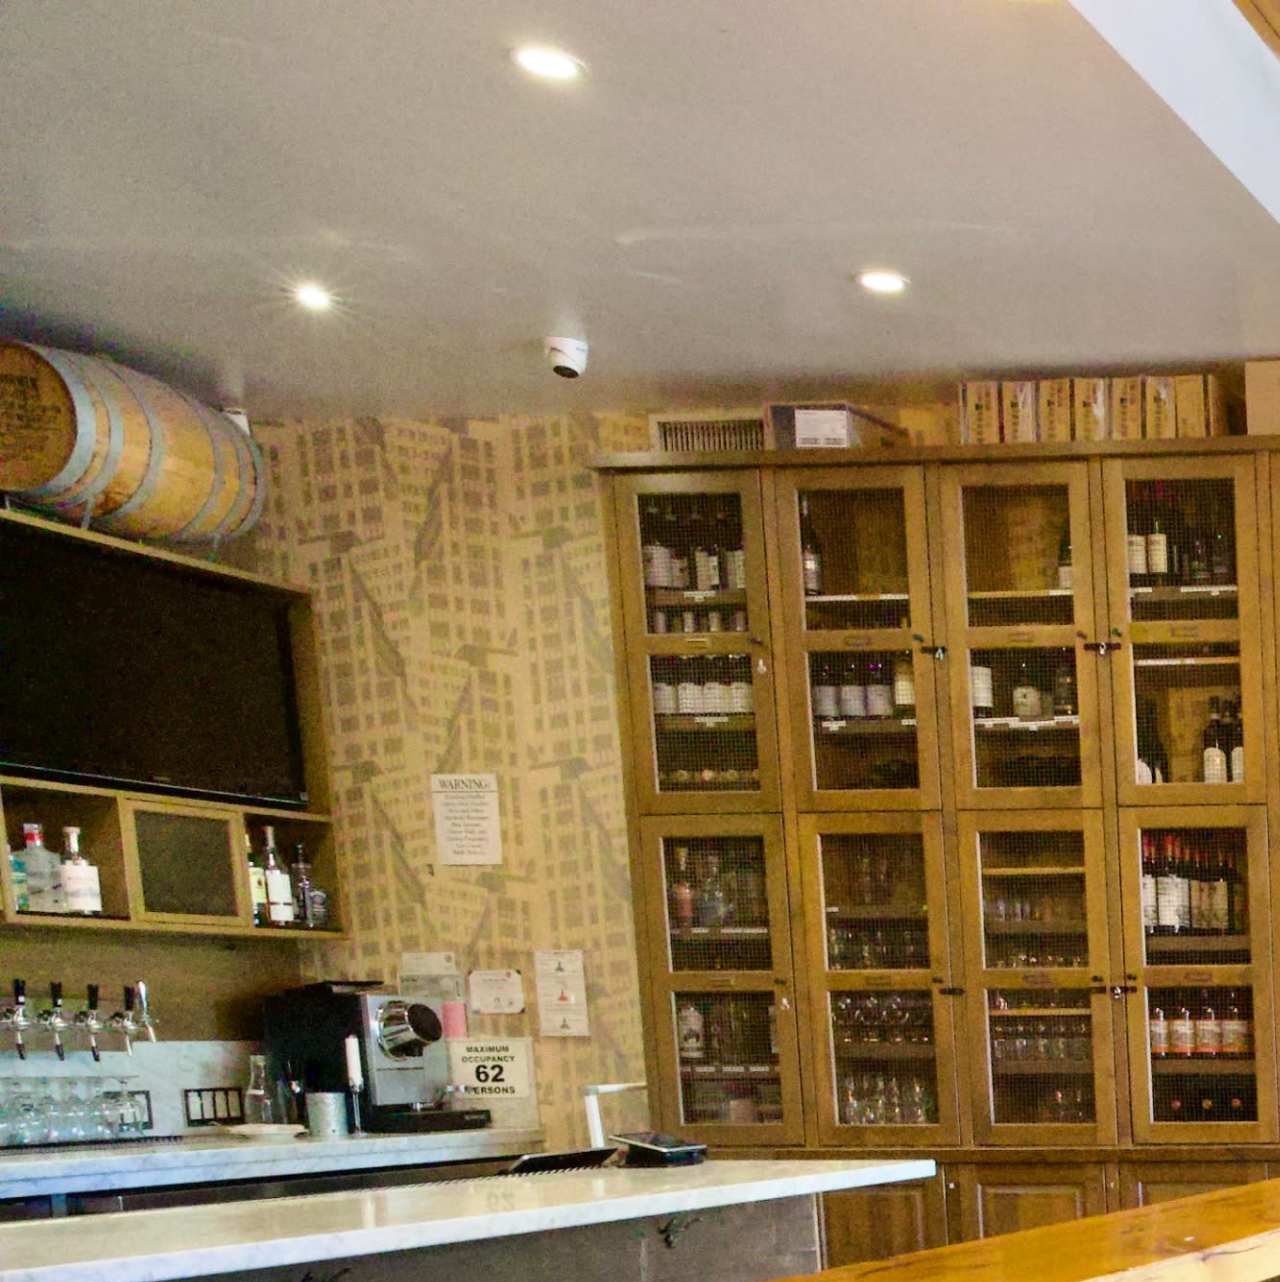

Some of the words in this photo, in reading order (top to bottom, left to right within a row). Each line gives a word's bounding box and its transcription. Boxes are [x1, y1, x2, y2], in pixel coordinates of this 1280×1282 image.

[465, 1045, 510, 1053] MAXIMUM
[461, 1054, 516, 1063] OCCUPANCY
[474, 1064, 506, 1083] 62
[464, 1086, 516, 1095] PERSONS
